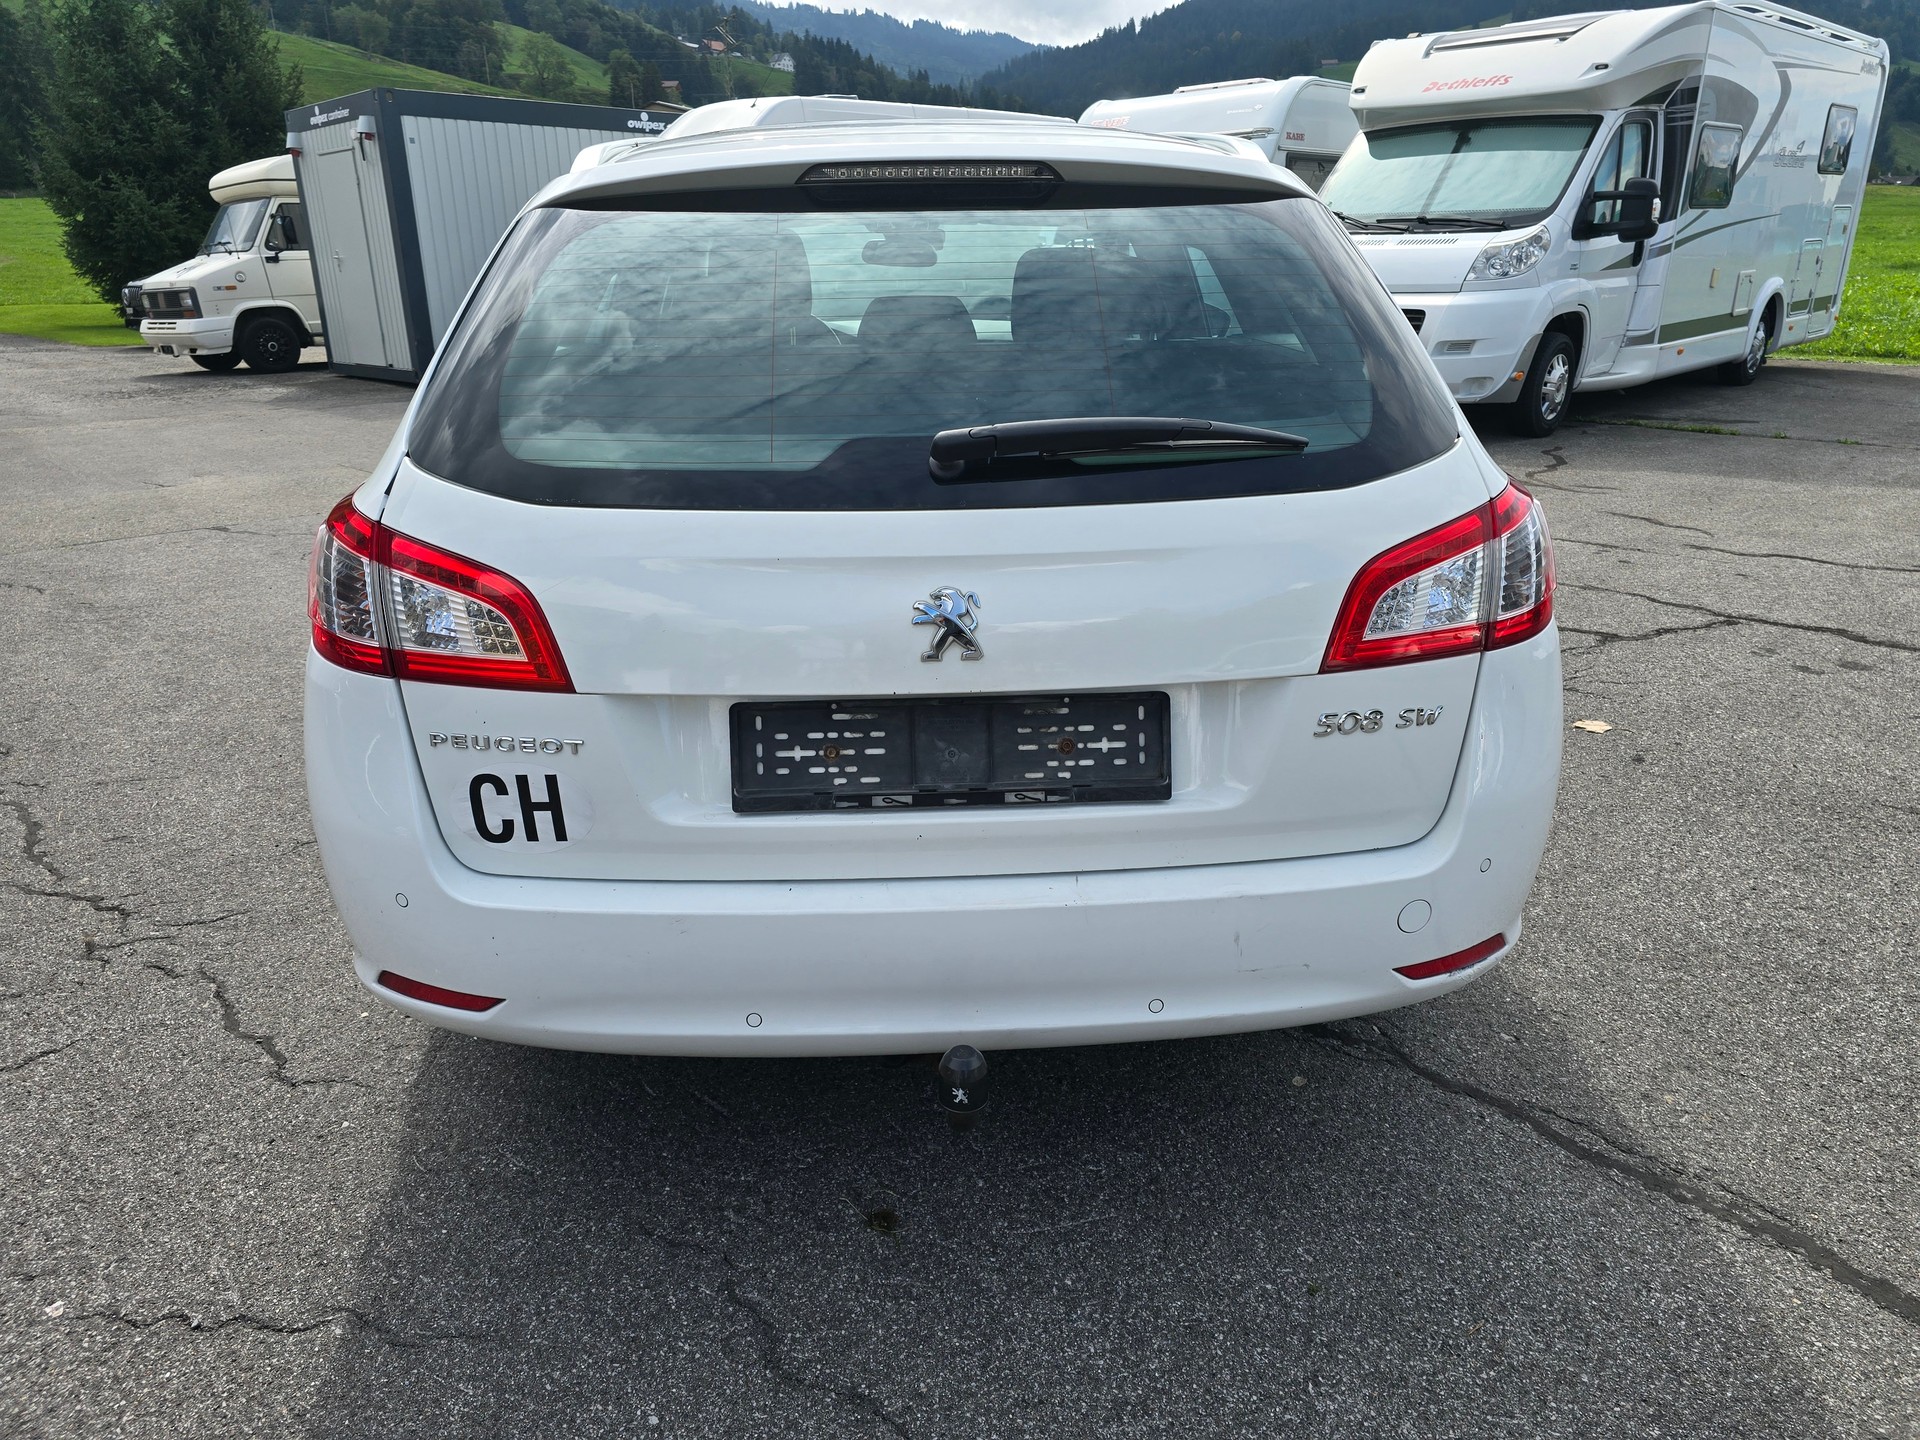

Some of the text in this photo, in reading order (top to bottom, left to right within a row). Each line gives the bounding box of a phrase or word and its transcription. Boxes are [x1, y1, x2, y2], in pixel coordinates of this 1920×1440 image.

[1422, 74, 1514, 93] Dethleffs
[310, 105, 328, 126] owipex
[627, 112, 666, 132] owipex
[1313, 704, 1444, 738] 508 SW
[429, 732, 584, 755] PEUGEOT
[468, 773, 568, 844] CH
